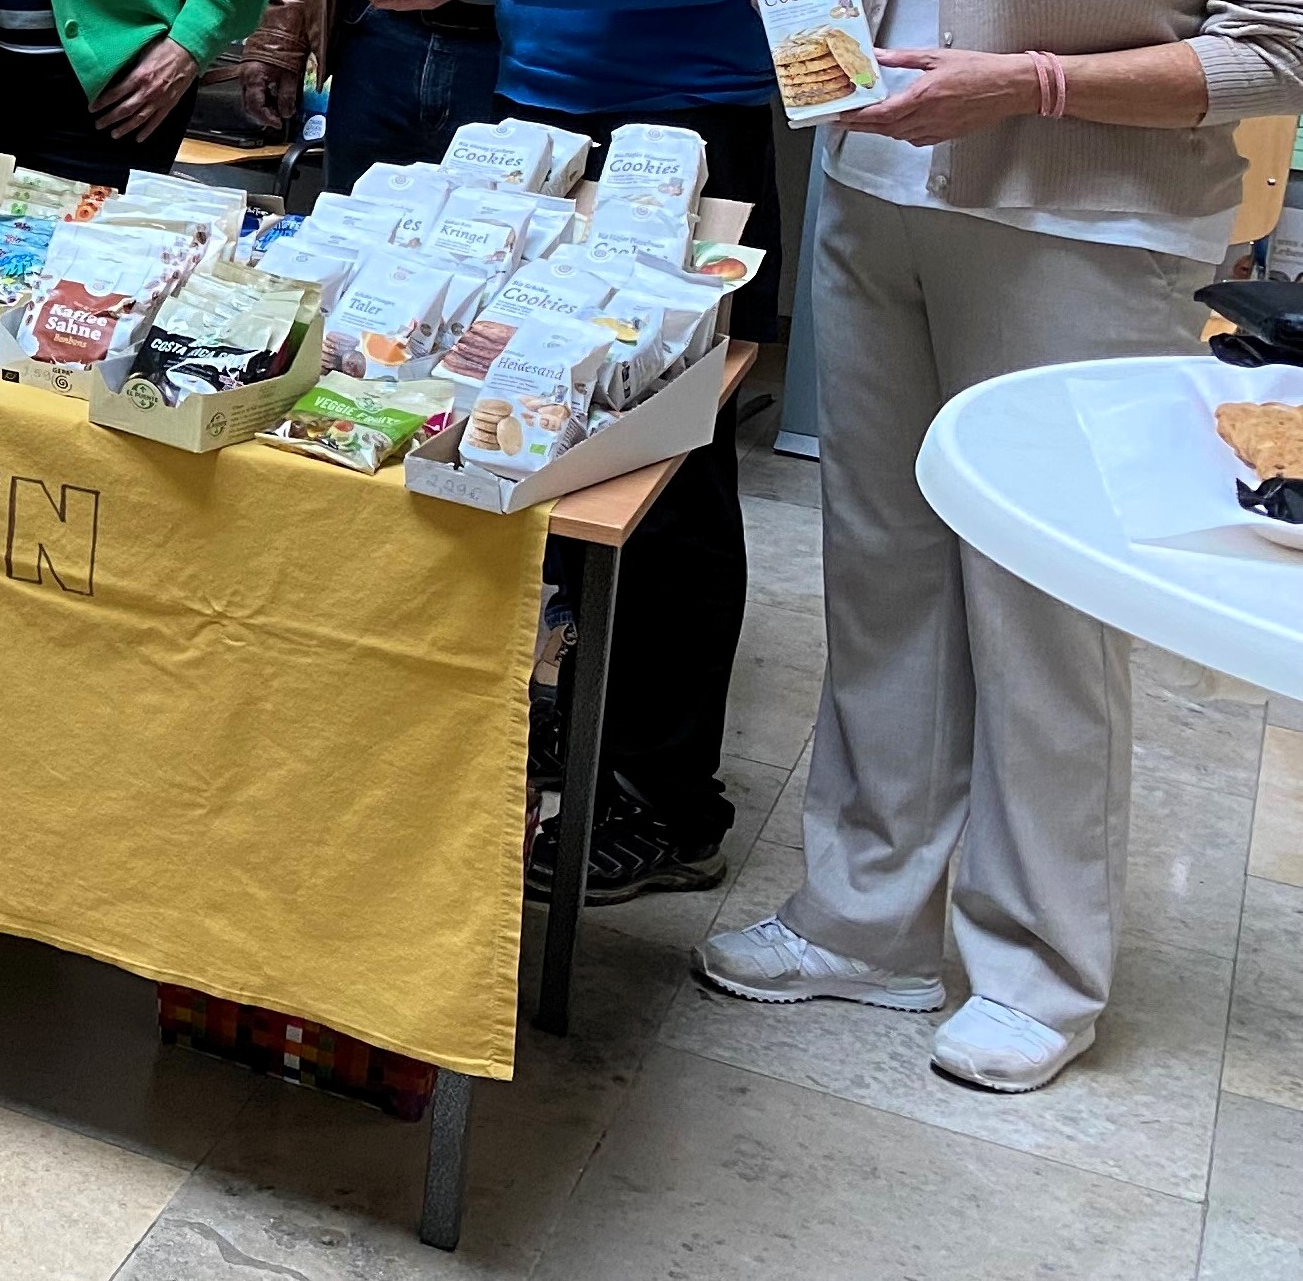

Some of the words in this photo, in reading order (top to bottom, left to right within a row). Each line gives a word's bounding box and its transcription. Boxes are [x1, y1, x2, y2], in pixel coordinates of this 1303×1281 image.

[453, 147, 523, 167] Cookies
[609, 159, 681, 175] Cookies
[440, 225, 490, 245] Kringel
[349, 297, 384, 315] Taler
[503, 287, 577, 315] Cookies
[49, 303, 108, 327] Kaffee
[45, 317, 102, 341] Sahne
[53, 333, 88, 348] Bonbons
[151, 337, 188, 355] COSTA
[497, 357, 565, 381] Heidesand
[313, 395, 355, 417] VEGGIE
